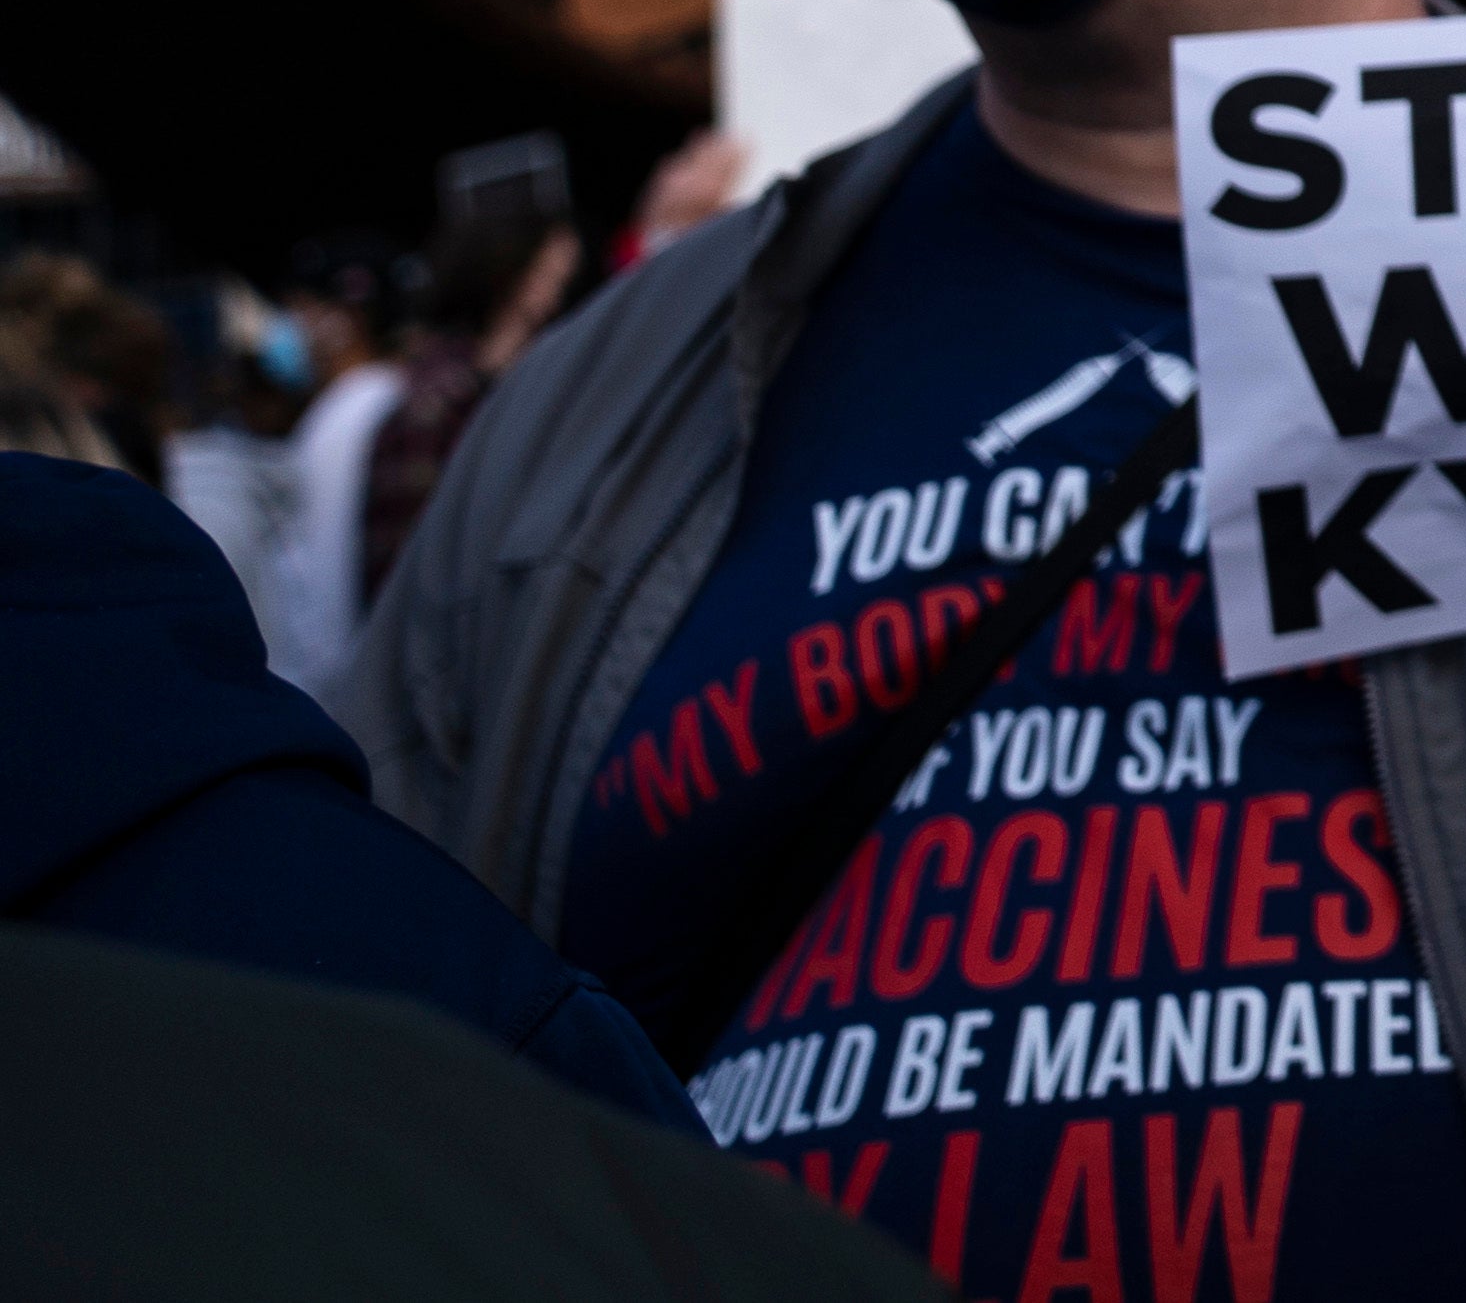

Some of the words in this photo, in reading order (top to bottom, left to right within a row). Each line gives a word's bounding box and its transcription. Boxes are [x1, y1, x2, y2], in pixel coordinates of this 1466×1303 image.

[809, 475, 970, 596] YOU
[1050, 571, 1207, 679] MY
[965, 703, 1106, 804] YOU
[1115, 695, 1265, 795] SAY
[881, 1006, 995, 1121] BE
[926, 1097, 1308, 1303] LAW
